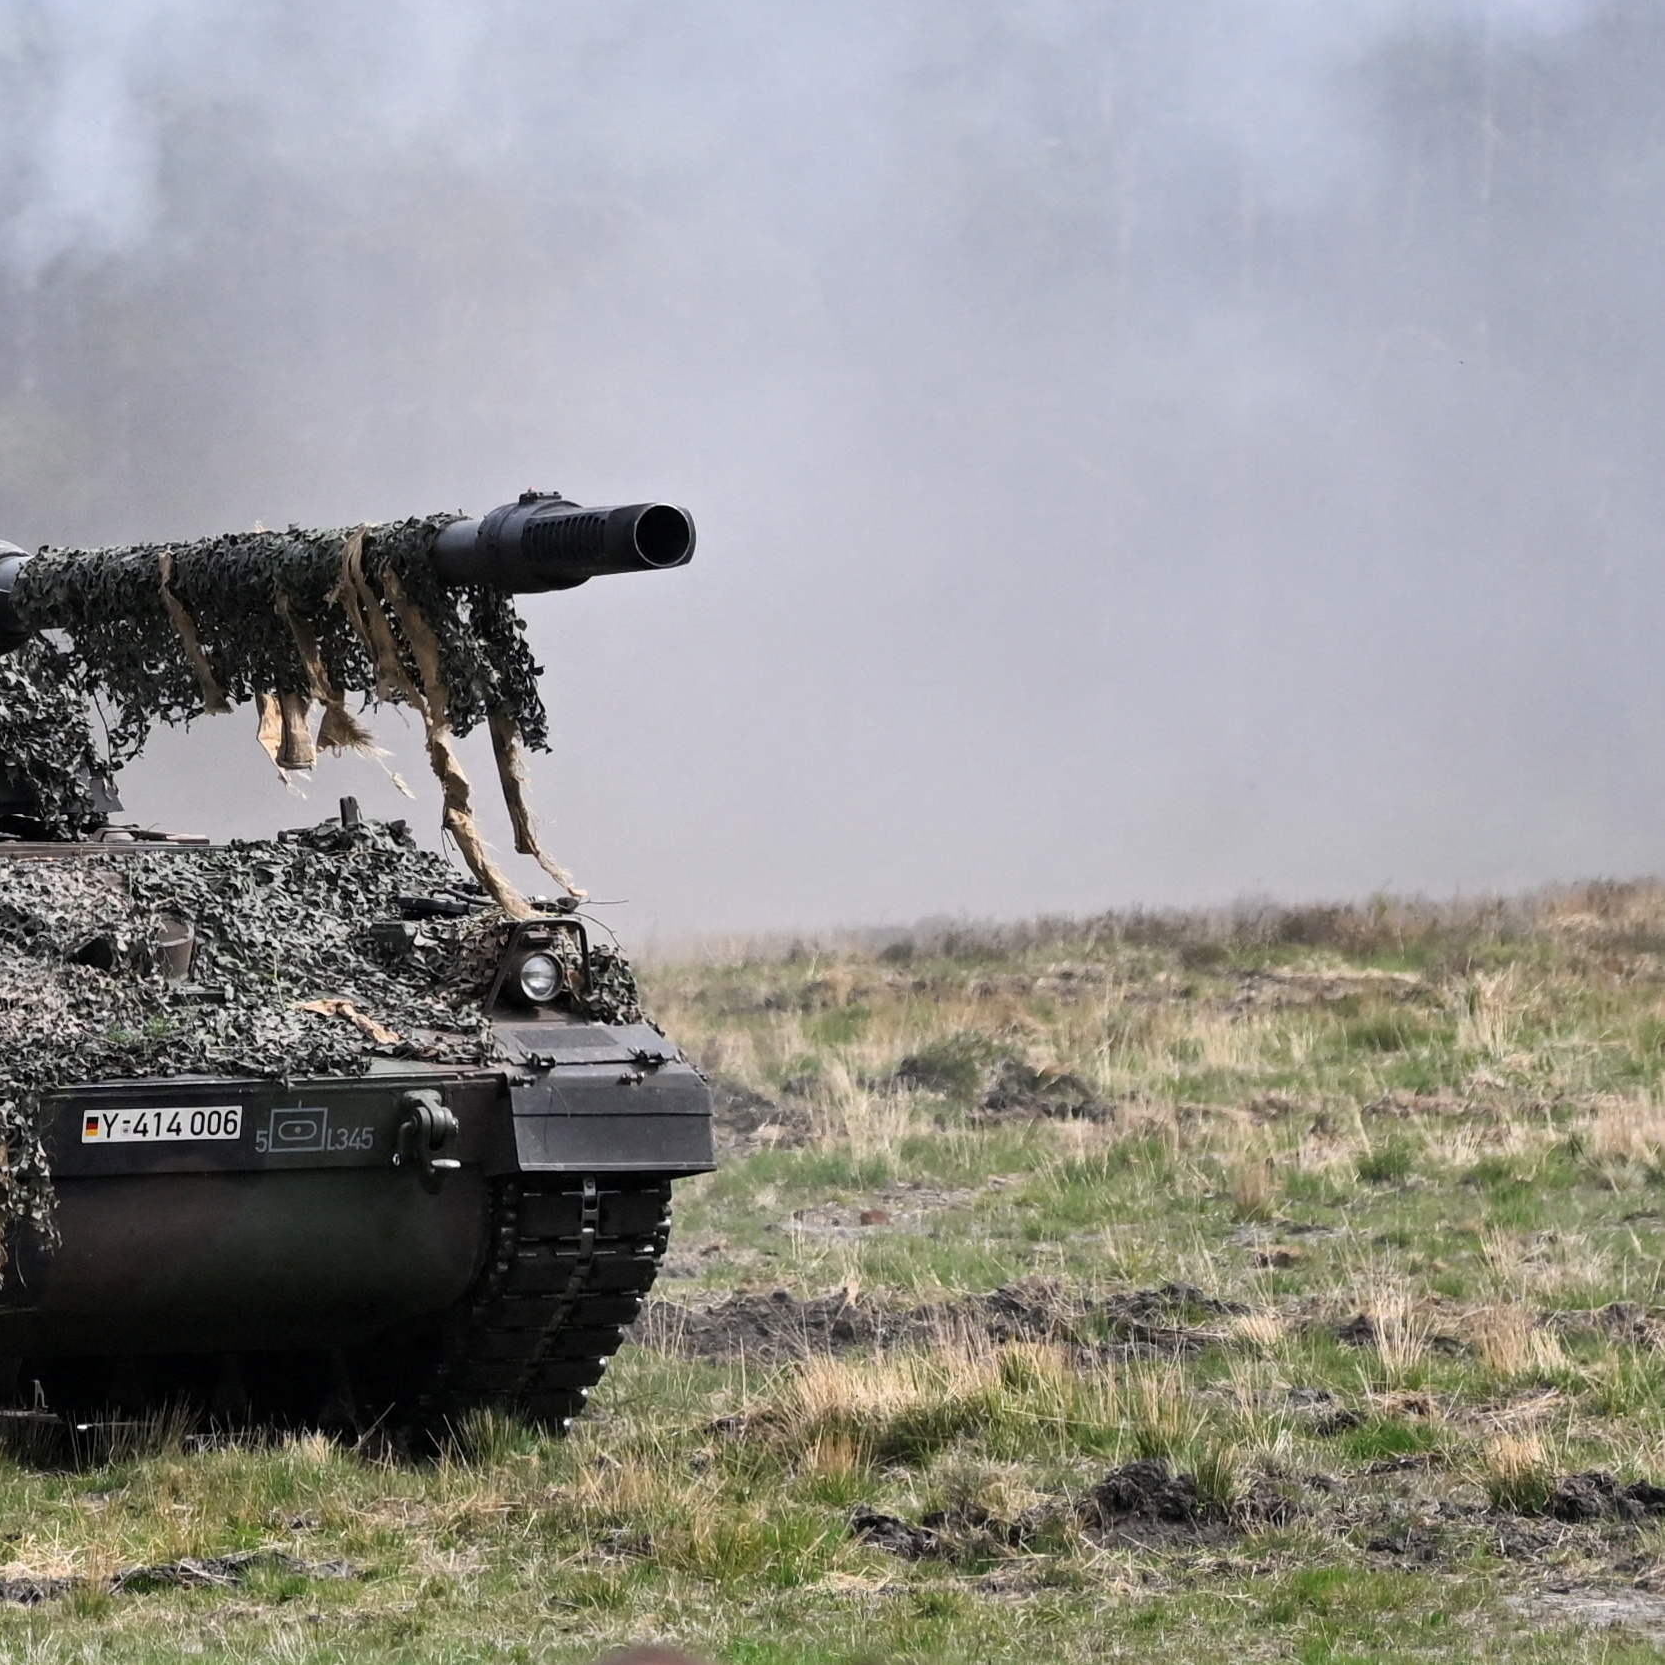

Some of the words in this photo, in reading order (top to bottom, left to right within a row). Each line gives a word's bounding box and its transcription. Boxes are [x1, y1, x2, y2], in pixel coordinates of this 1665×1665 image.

[190, 1109, 239, 1136] 006
[254, 1130, 268, 1153] 5
[326, 1126, 375, 1151] L345
